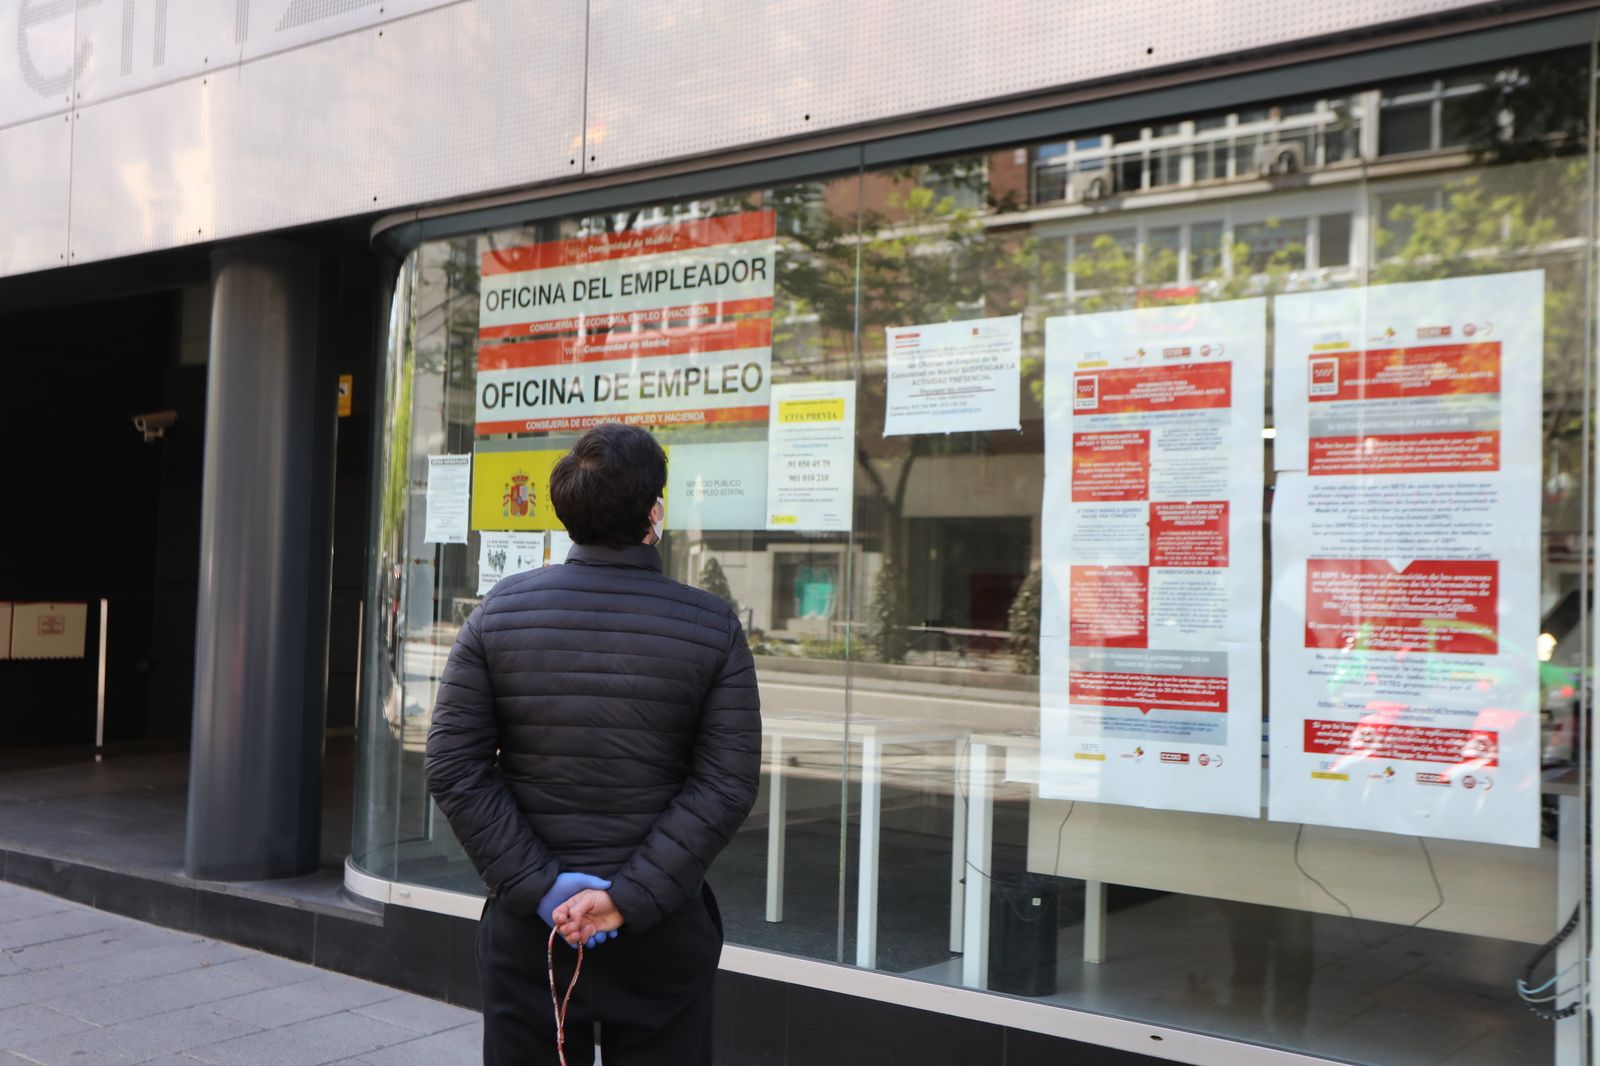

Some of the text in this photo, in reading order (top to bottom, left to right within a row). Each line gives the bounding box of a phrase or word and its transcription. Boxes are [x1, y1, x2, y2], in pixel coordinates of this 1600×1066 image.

[633, 239, 643, 248] de
[645, 233, 673, 247] Madrid
[486, 257, 767, 312] OFICINA DEL EMPLEADOR
[529, 318, 574, 333] CONSEJERÍA
[584, 337, 669, 354] Comunidad de Madrid
[891, 370, 927, 379] Comunidad
[937, 367, 960, 376] Madrid
[1006, 362, 1015, 370] LA
[918, 360, 944, 369] Oficinas
[482, 362, 762, 410] OFICINA DE EMPLEO
[912, 374, 992, 387] ACTIVIDAD PRESENCIAL
[526, 416, 570, 430] CONSEJERÍA
[571, 417, 581, 427] DE
[625, 413, 656, 424] EMPLEO
[664, 411, 705, 423] HACIENDA
[785, 412, 838, 423] CITA PREVIA
[789, 474, 801, 482] 901
[720, 488, 745, 497] ESTATAL
